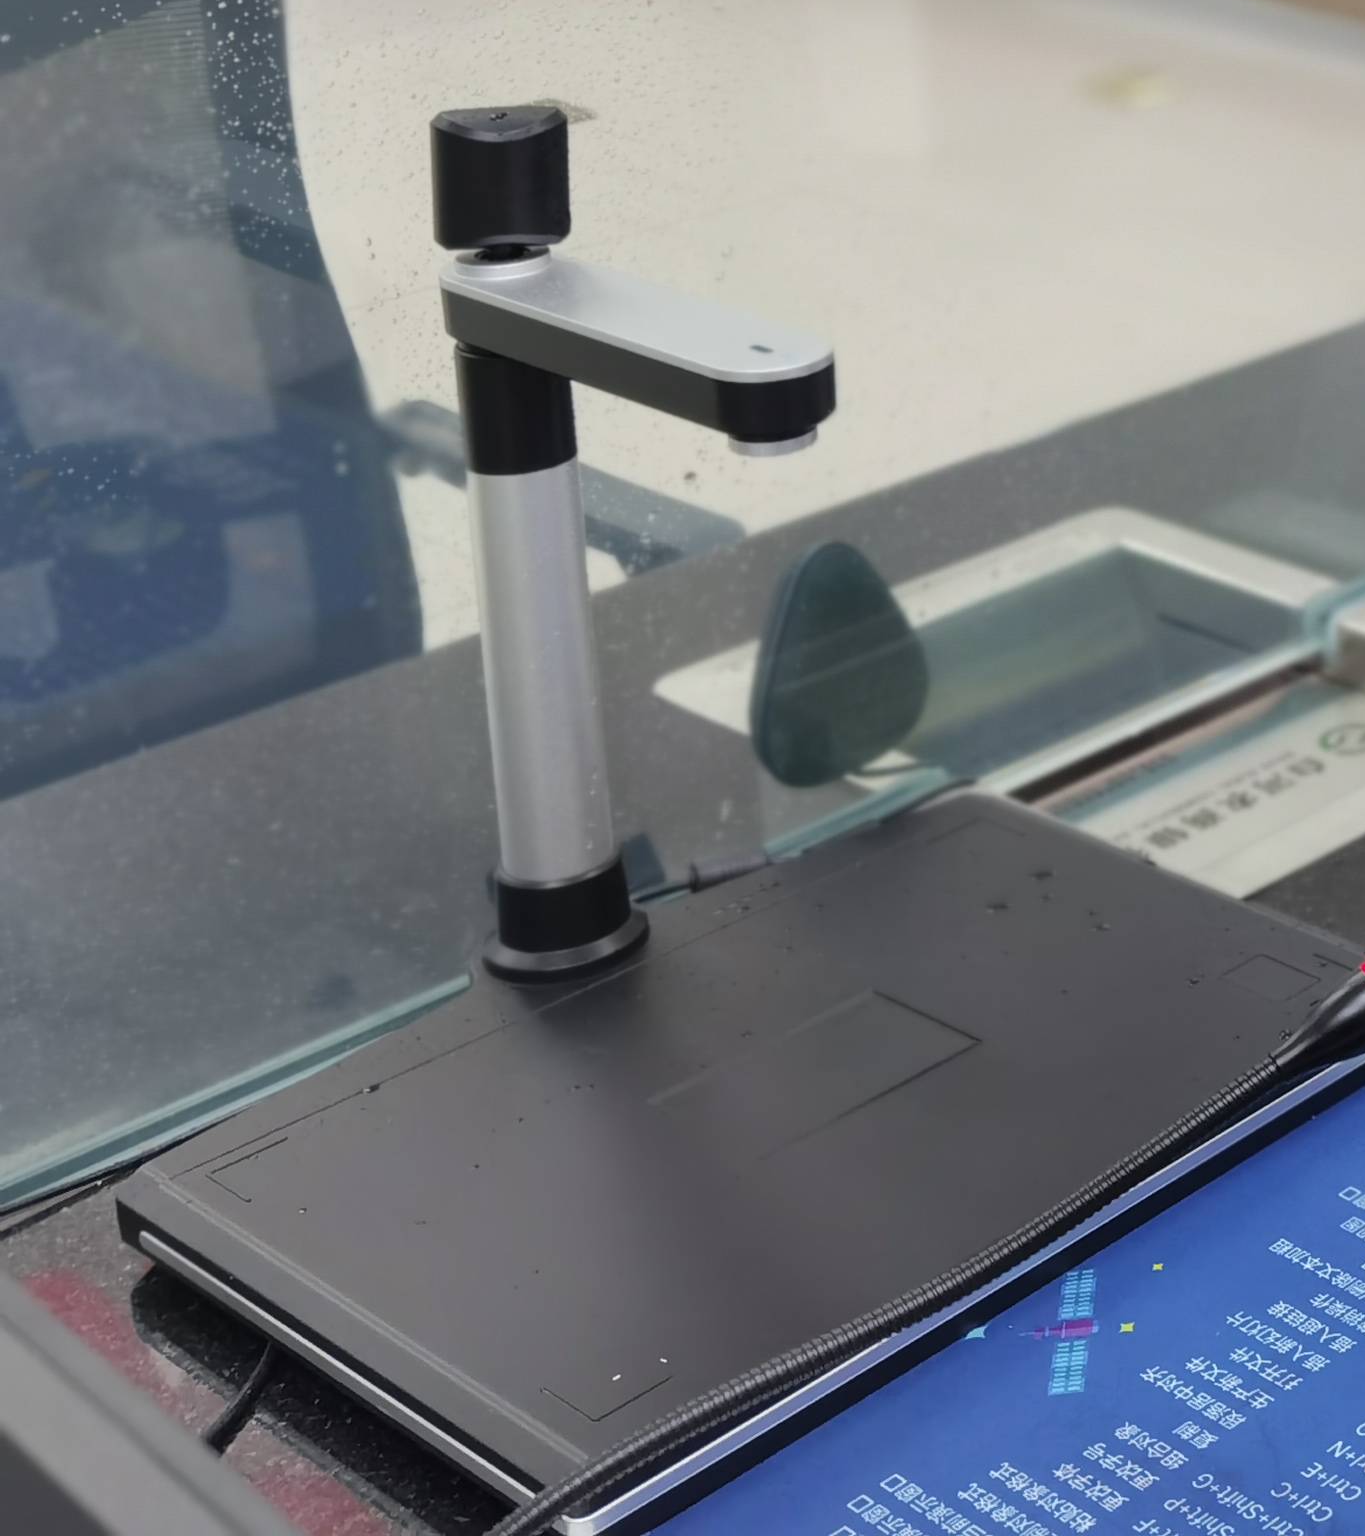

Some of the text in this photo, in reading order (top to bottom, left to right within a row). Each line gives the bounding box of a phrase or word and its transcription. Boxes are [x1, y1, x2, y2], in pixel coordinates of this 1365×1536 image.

[1227, 1312, 1330, 1372] 插入新幻灯片
[1267, 1301, 1357, 1353] 插入超链接
[1186, 1357, 1274, 1409] 生产新文件
[1229, 1347, 1303, 1390] 打开文件
[1115, 1422, 1189, 1469] 组合对象
[1140, 1366, 1361, 1500] Ctrl+E 段落居中对齐
[1053, 1464, 1129, 1512] 更改字体
[1083, 1443, 1160, 1491] 更改字号
[1172, 1421, 1332, 1522] Ctrl+C 复制
[989, 1462, 1096, 1533] 粘贴对象格式
